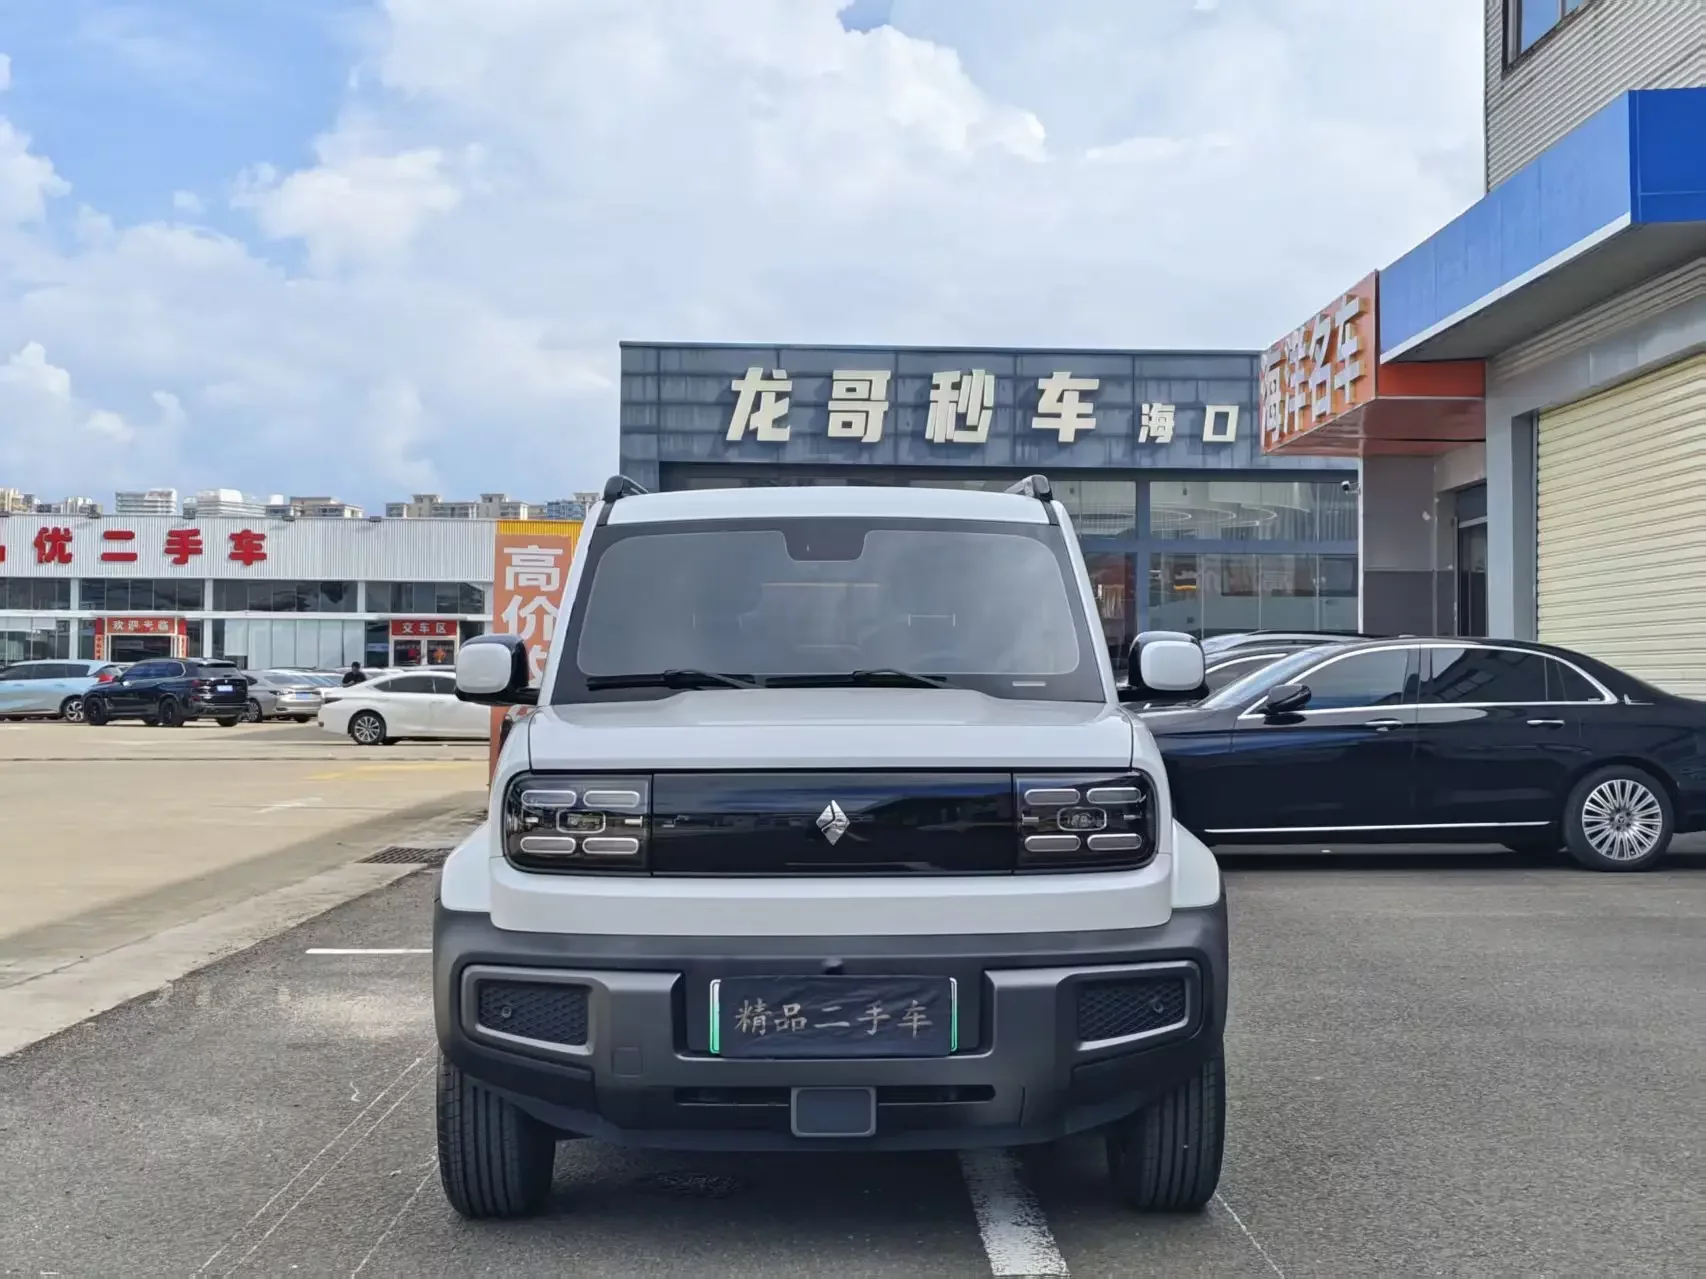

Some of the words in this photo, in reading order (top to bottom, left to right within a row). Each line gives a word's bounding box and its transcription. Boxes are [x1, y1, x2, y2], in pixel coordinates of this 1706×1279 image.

[1261, 294, 1361, 448] 海洋名车
[726, 367, 1100, 444] 龙哥秒车
[1138, 403, 1239, 444] 海口
[0, 527, 267, 566] 优二手车
[402, 622, 447, 634] 交车区
[734, 998, 934, 1039] 精品二手车
